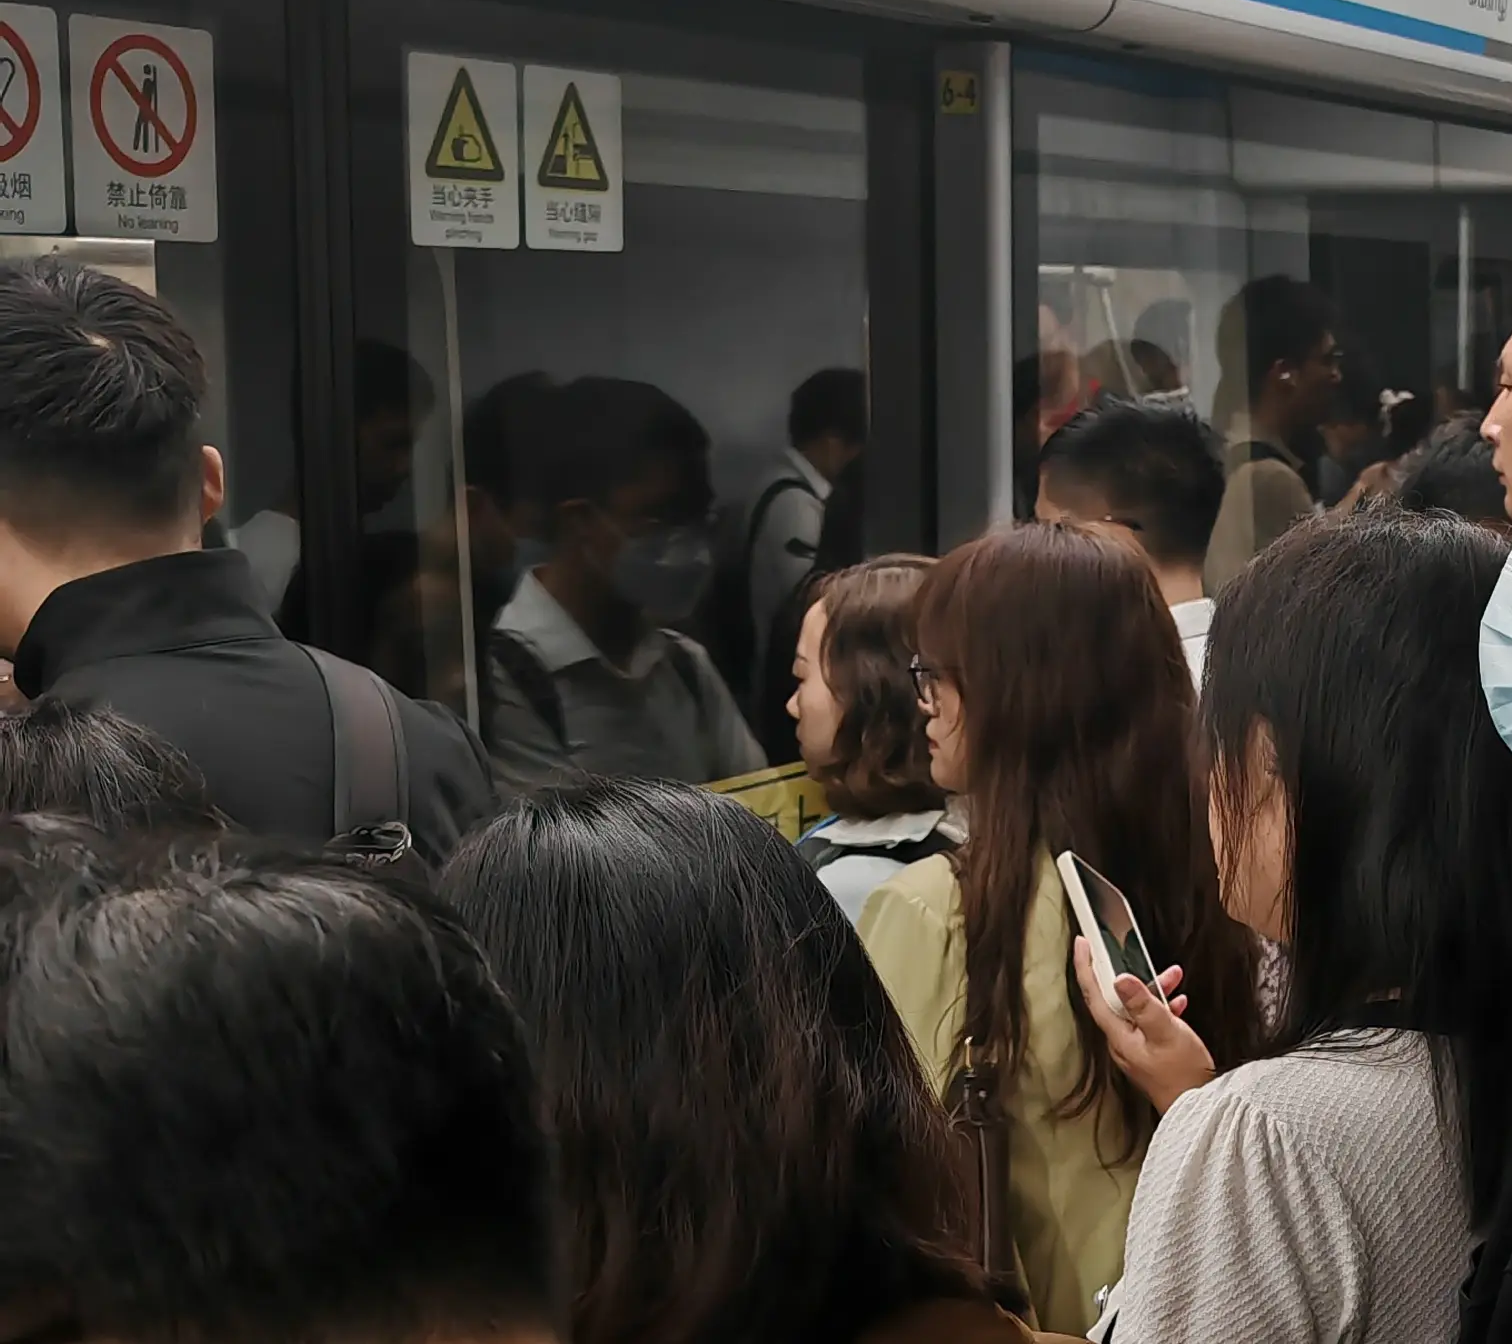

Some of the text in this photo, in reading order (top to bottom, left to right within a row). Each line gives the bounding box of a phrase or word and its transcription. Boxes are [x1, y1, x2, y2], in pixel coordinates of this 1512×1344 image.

[106, 180, 188, 210] 禁止倚靠
[431, 184, 495, 209] 当心夹手
[118, 213, 178, 234] No leaning
